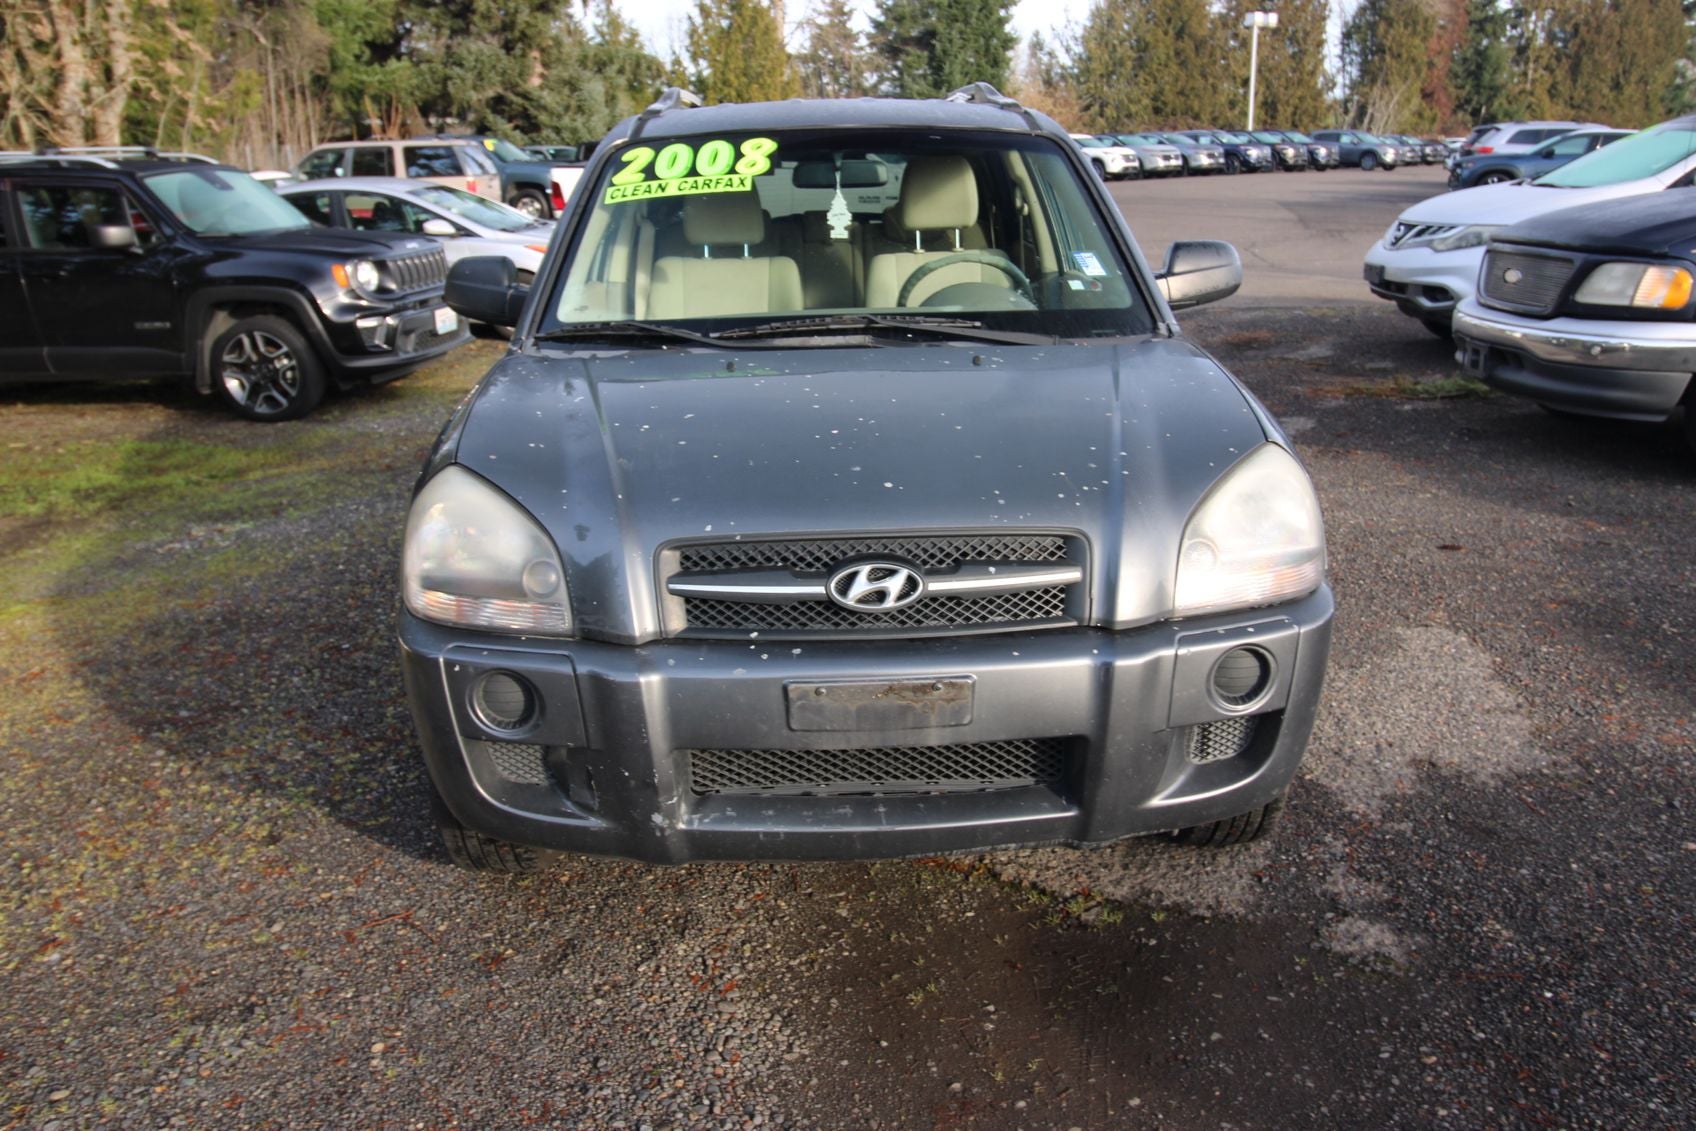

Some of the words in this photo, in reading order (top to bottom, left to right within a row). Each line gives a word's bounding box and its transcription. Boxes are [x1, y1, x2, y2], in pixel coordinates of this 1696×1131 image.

[611, 137, 778, 186] 2008
[610, 181, 669, 200] CLEAN
[677, 176, 748, 192] CARFAX
